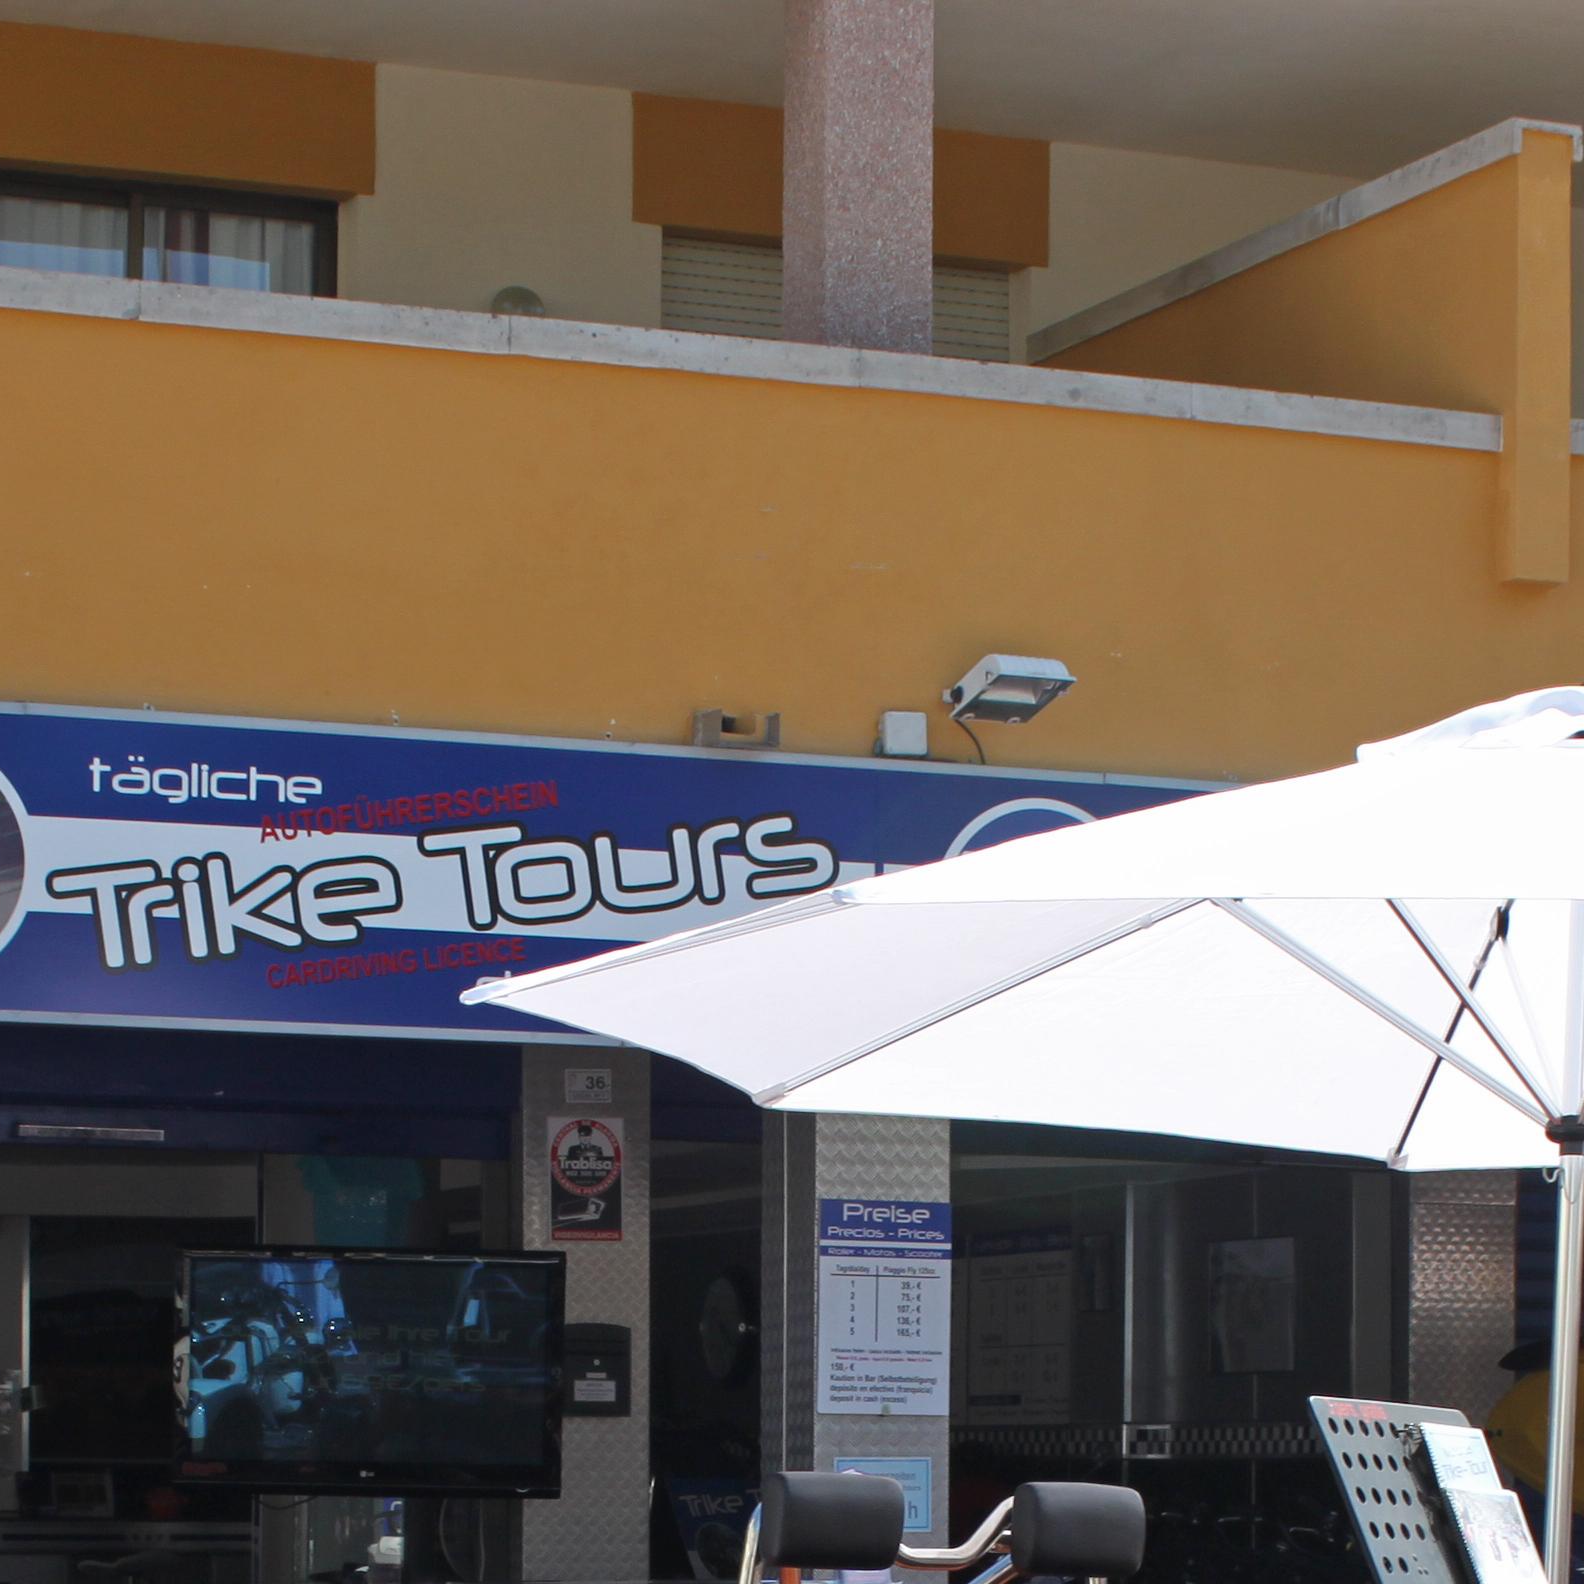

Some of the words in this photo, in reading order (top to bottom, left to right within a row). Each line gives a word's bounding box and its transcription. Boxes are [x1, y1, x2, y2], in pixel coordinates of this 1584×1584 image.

[89, 756, 323, 805] tägliche
[260, 780, 559, 844] AUTOFÜHRERSCHEIN
[46, 851, 403, 974] Trike
[417, 813, 840, 930] Tours
[266, 950, 418, 989] CARDRIVING
[424, 937, 526, 972] LICENCE
[585, 1076, 606, 1090] 36
[827, 1226, 885, 1239] Precios
[897, 1228, 945, 1240] Prices
[843, 1203, 930, 1224] Preise
